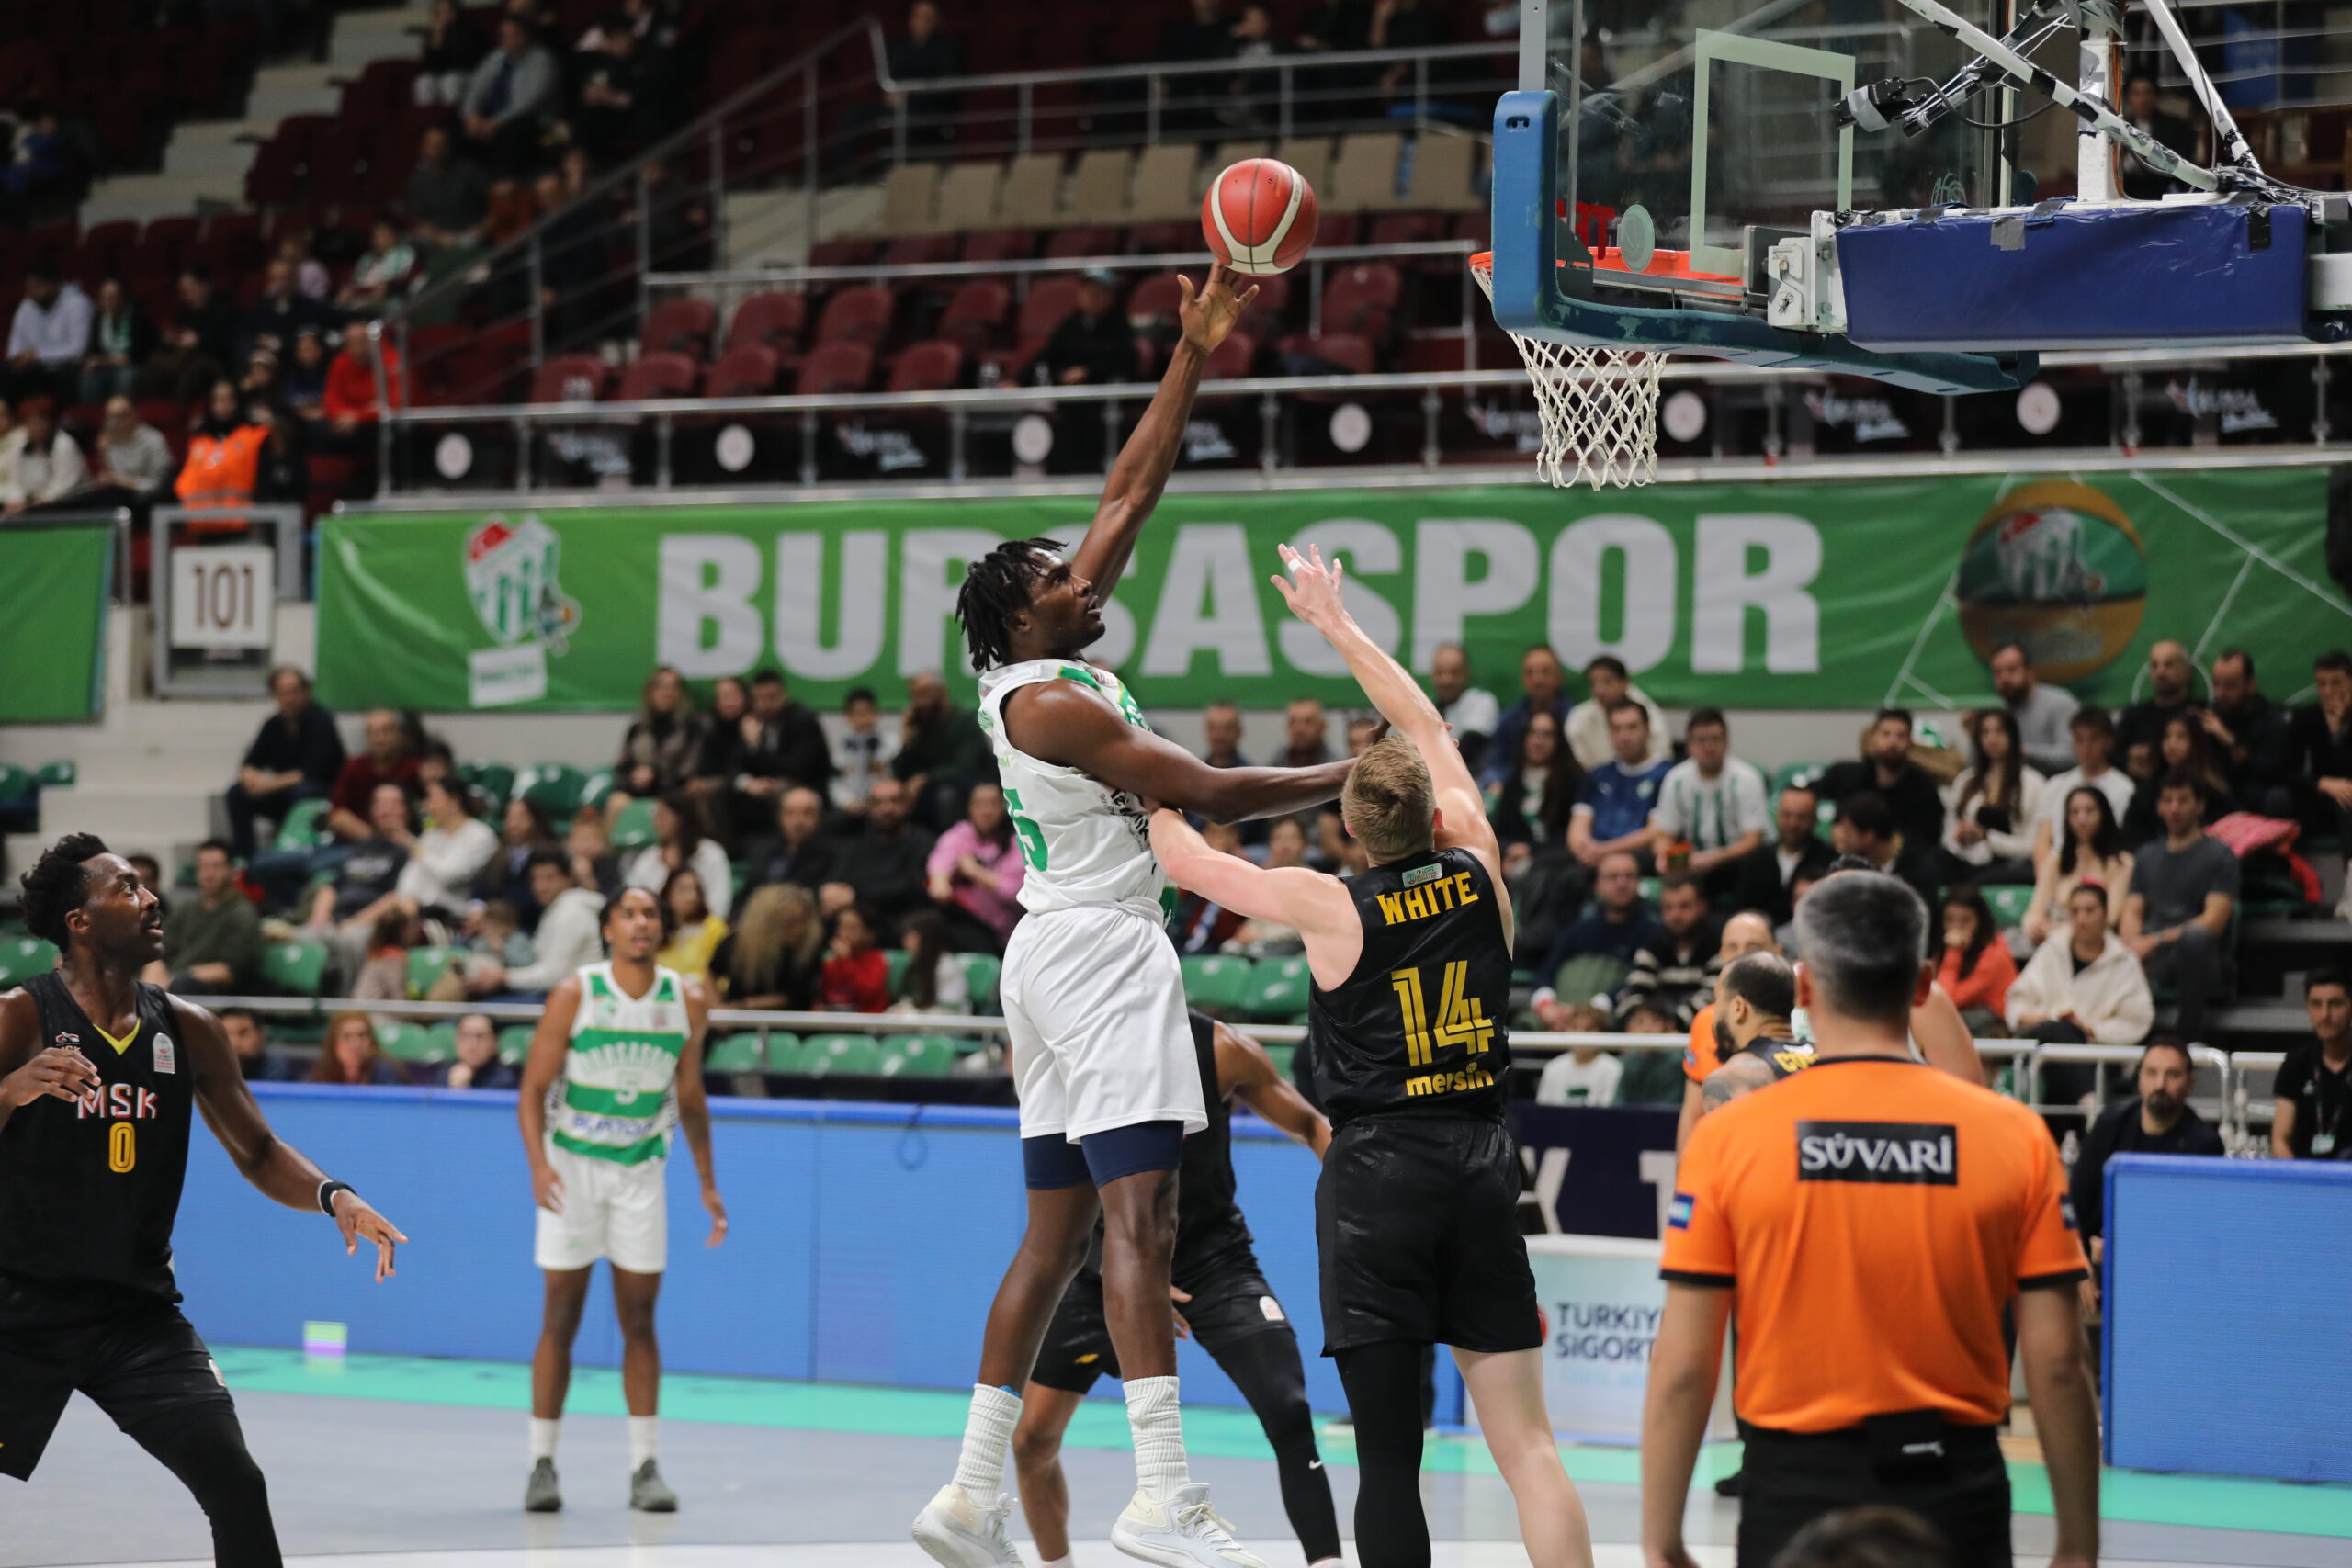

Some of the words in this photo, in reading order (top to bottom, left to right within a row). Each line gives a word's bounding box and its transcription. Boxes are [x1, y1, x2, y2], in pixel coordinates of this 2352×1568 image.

[194, 564, 254, 629] 101
[1375, 871, 1479, 926] WHITE
[1391, 960, 1495, 1066] 14
[77, 1083, 158, 1119] MSK
[1405, 1062, 1494, 1096] mersin
[108, 1122, 136, 1173] 0
